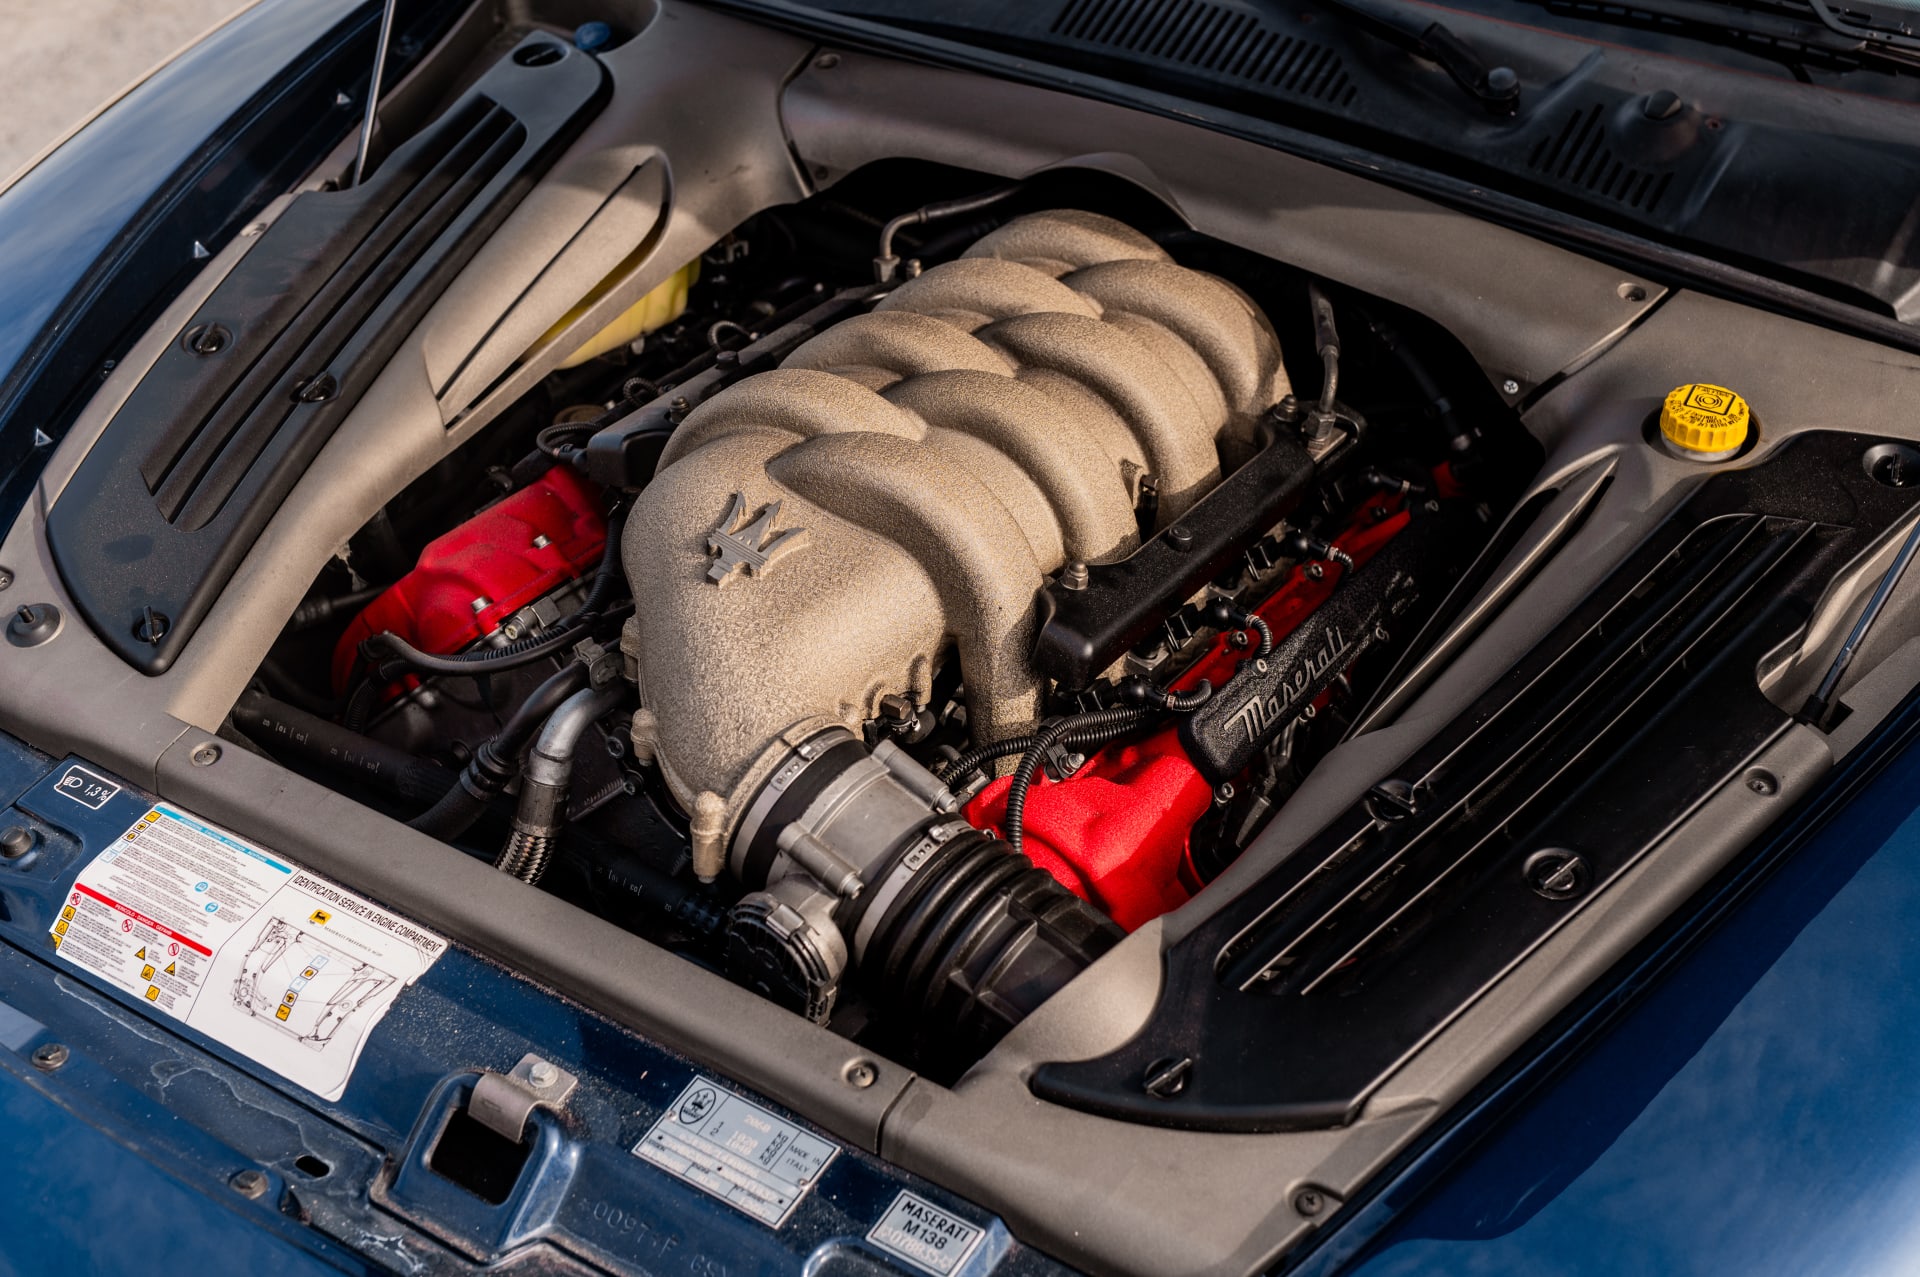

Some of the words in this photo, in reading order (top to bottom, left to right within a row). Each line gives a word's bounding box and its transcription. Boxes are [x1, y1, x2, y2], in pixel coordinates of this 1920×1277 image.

[1224, 626, 1352, 743] Maserati
[292, 874, 342, 904] IDENTIFICATION
[338, 896, 368, 916] SERVICE
[365, 910, 375, 920] IN
[371, 912, 397, 932] ENGINE
[394, 924, 443, 953] COMPARTMENT
[785, 1158, 811, 1173] ITALY
[789, 1144, 809, 1158] MADE
[812, 1156, 823, 1166] IN
[902, 1201, 970, 1242] MASERATI
